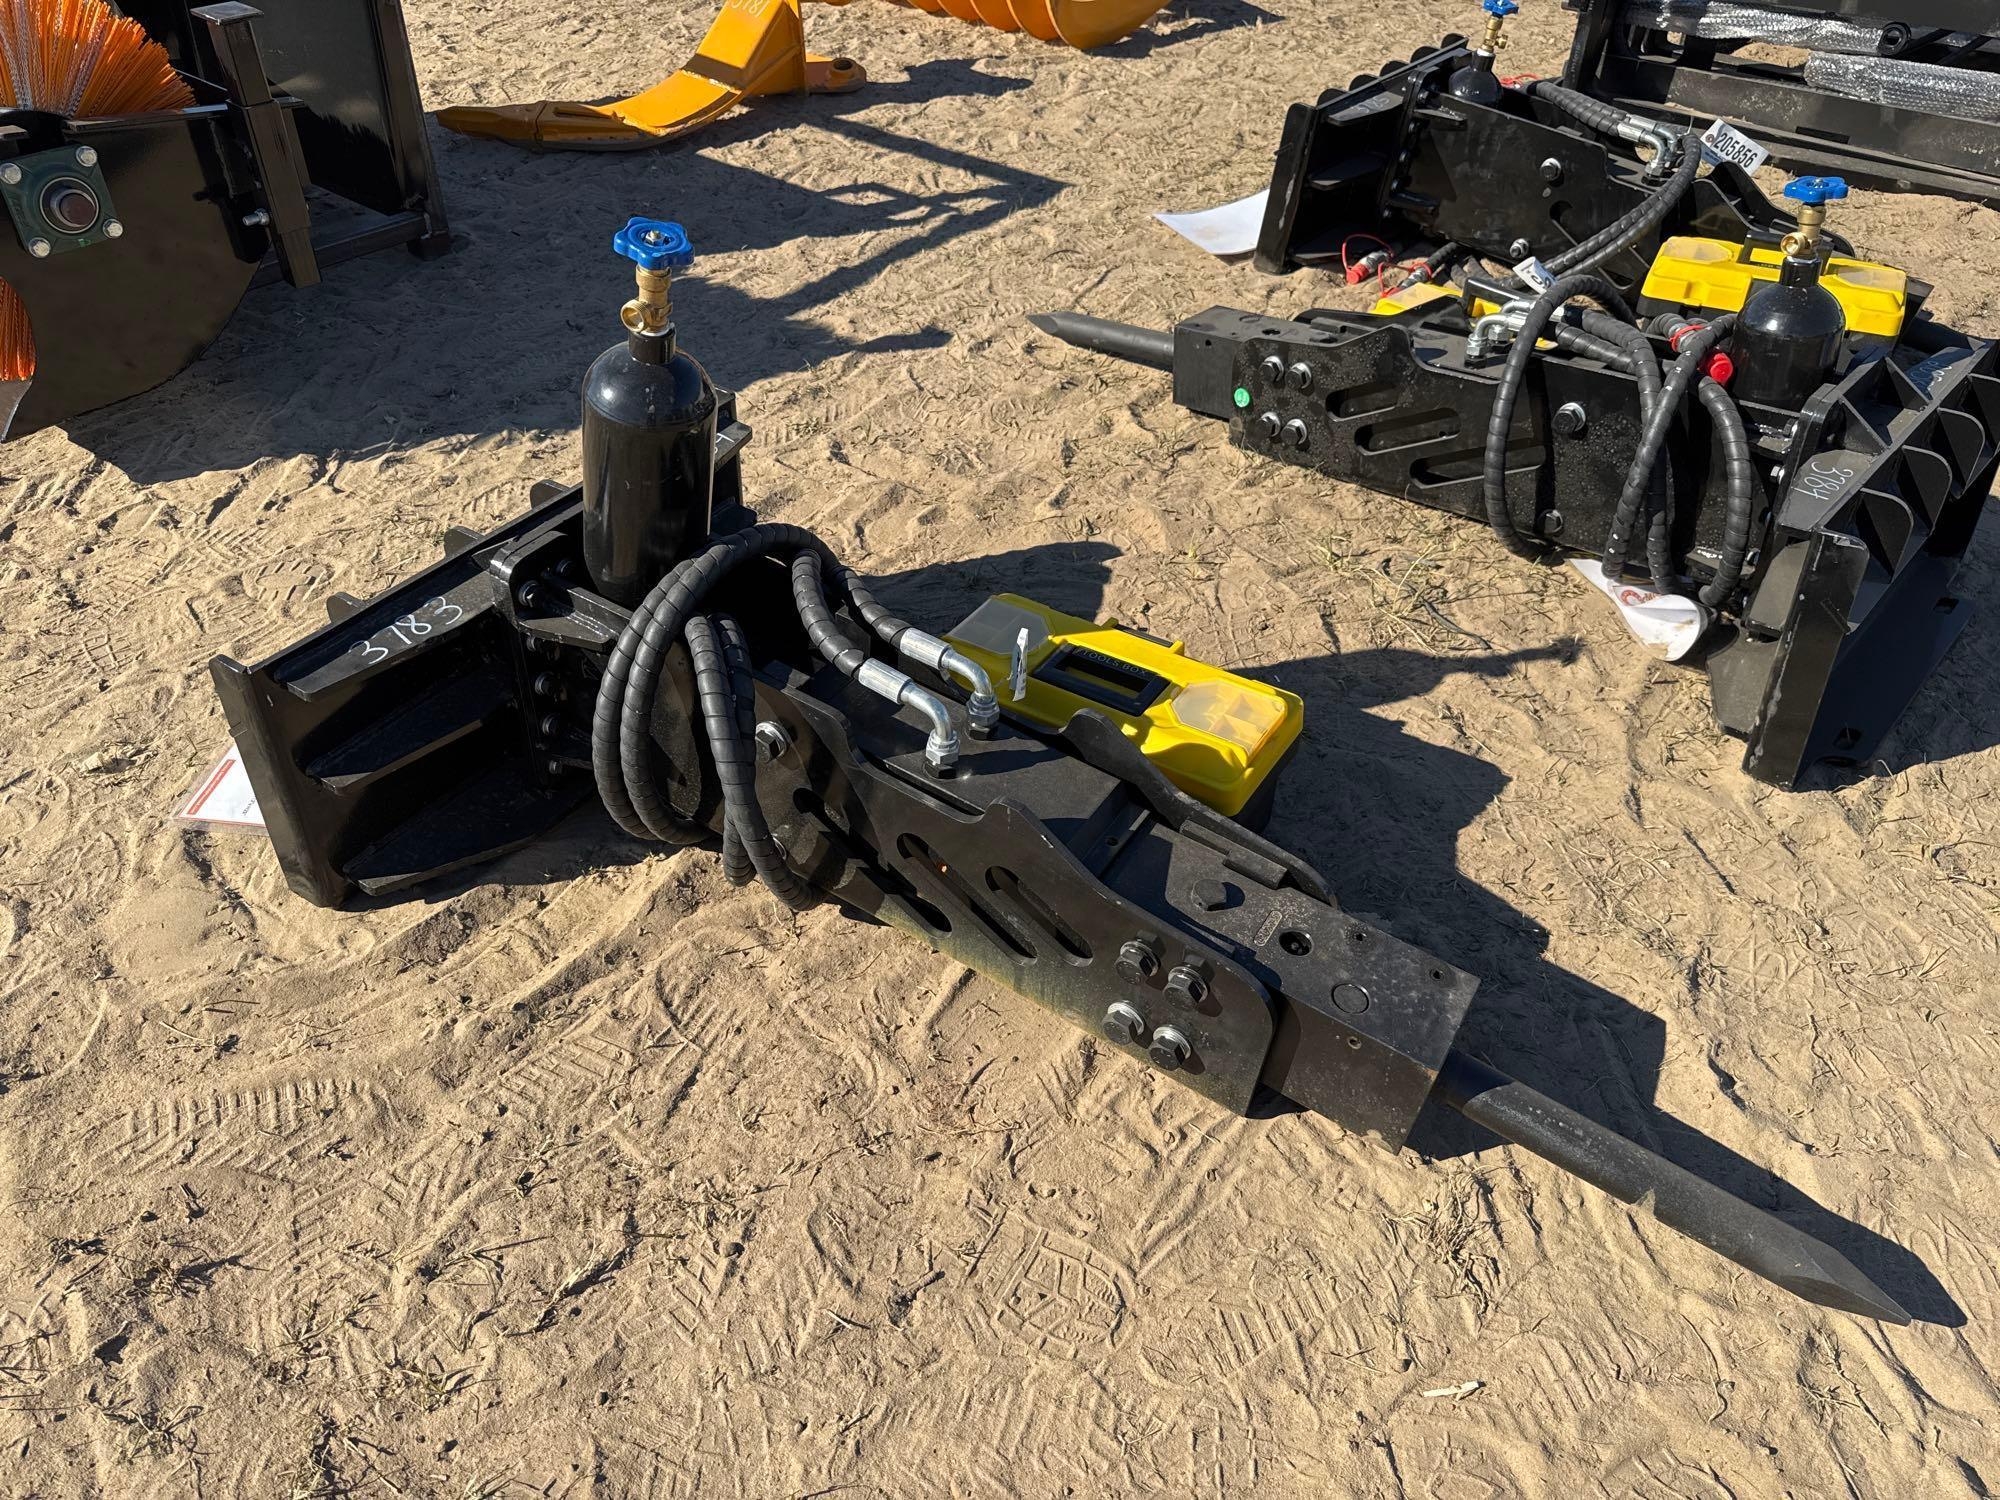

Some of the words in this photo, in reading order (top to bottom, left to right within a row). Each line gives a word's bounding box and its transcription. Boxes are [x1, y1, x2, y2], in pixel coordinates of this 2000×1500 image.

[1713, 132, 1758, 168] 205856
[1791, 461, 1854, 500] 3184
[348, 596, 463, 665] 3183
[1081, 649, 1120, 668] TOOLS
[1121, 662, 1148, 677] BOX
